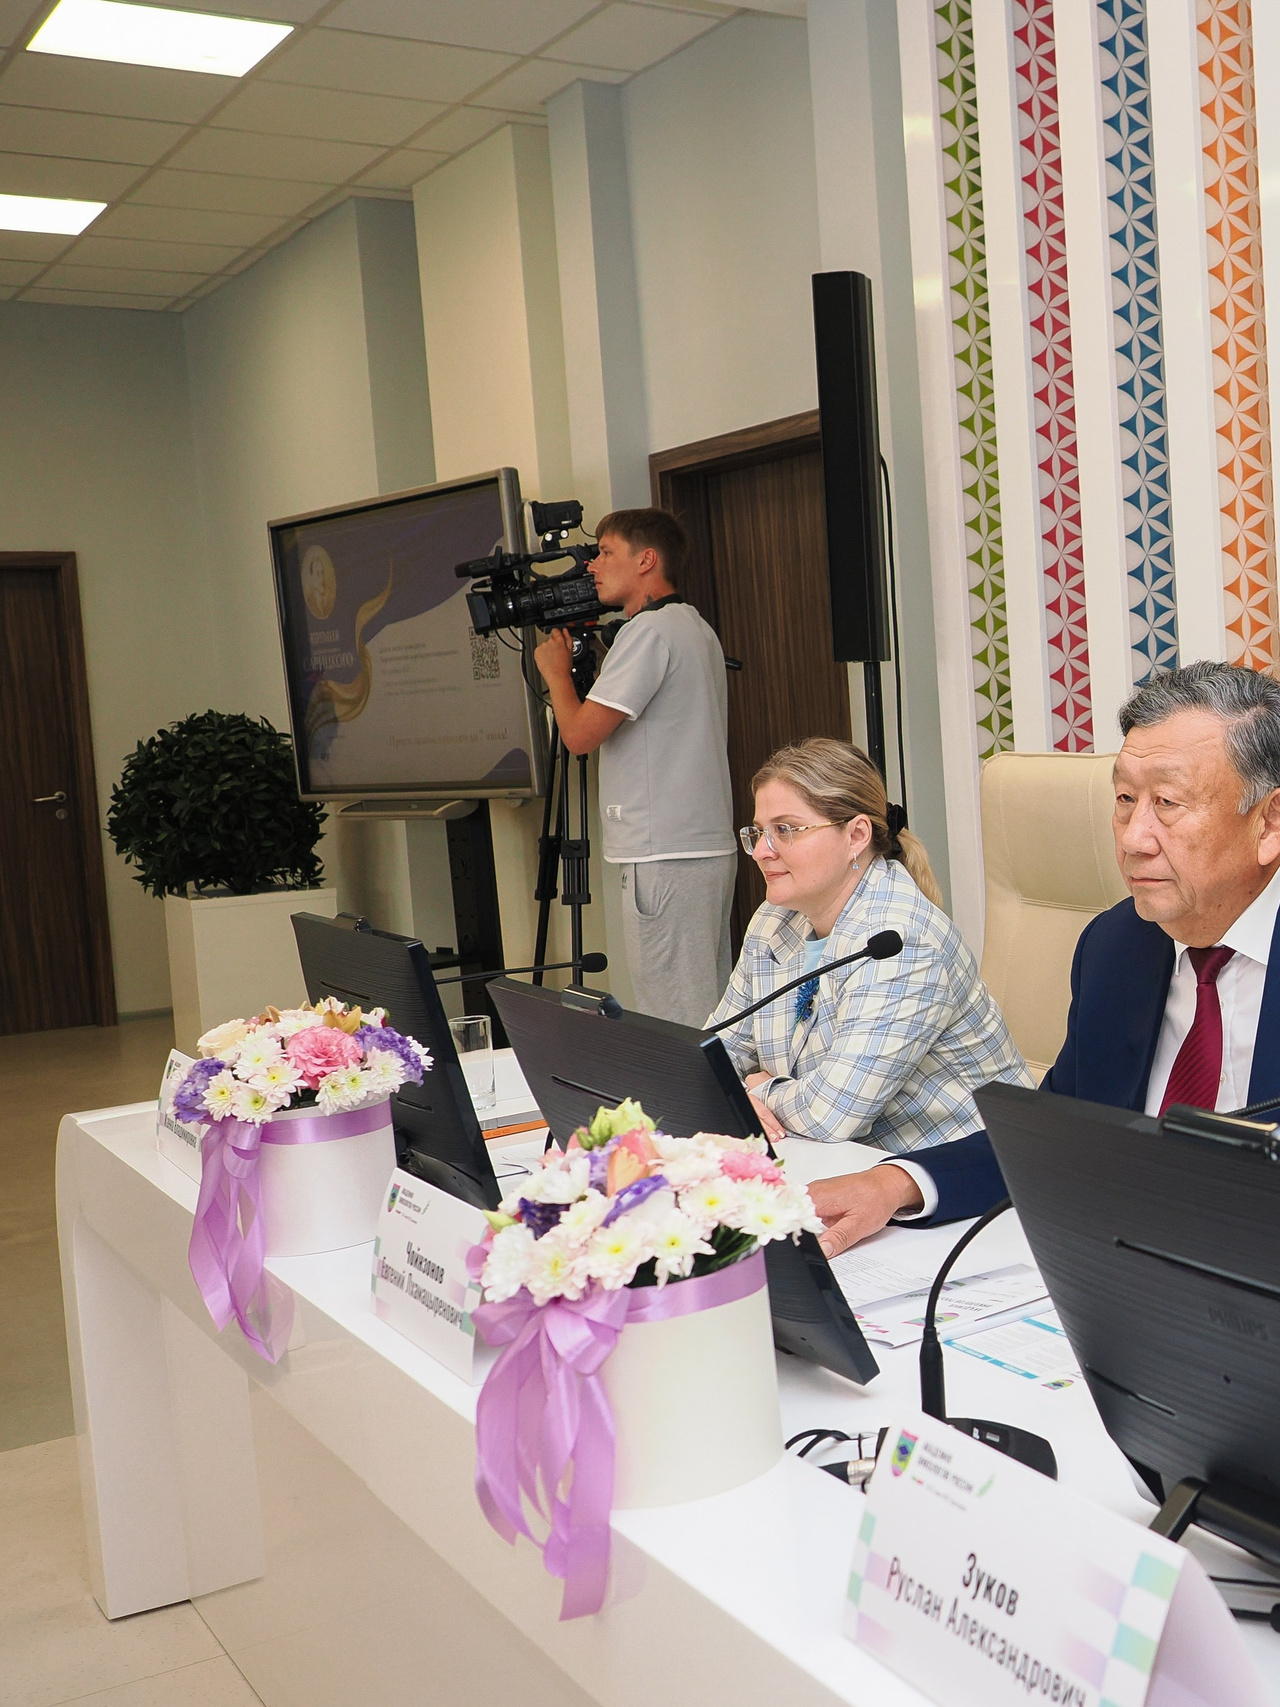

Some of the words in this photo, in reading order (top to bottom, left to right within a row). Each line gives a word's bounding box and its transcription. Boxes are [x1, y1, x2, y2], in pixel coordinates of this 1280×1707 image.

[886, 1556, 943, 1622] Руслан
[946, 1597, 1087, 1707] Александрович
[962, 1552, 1020, 1617] Зуков
